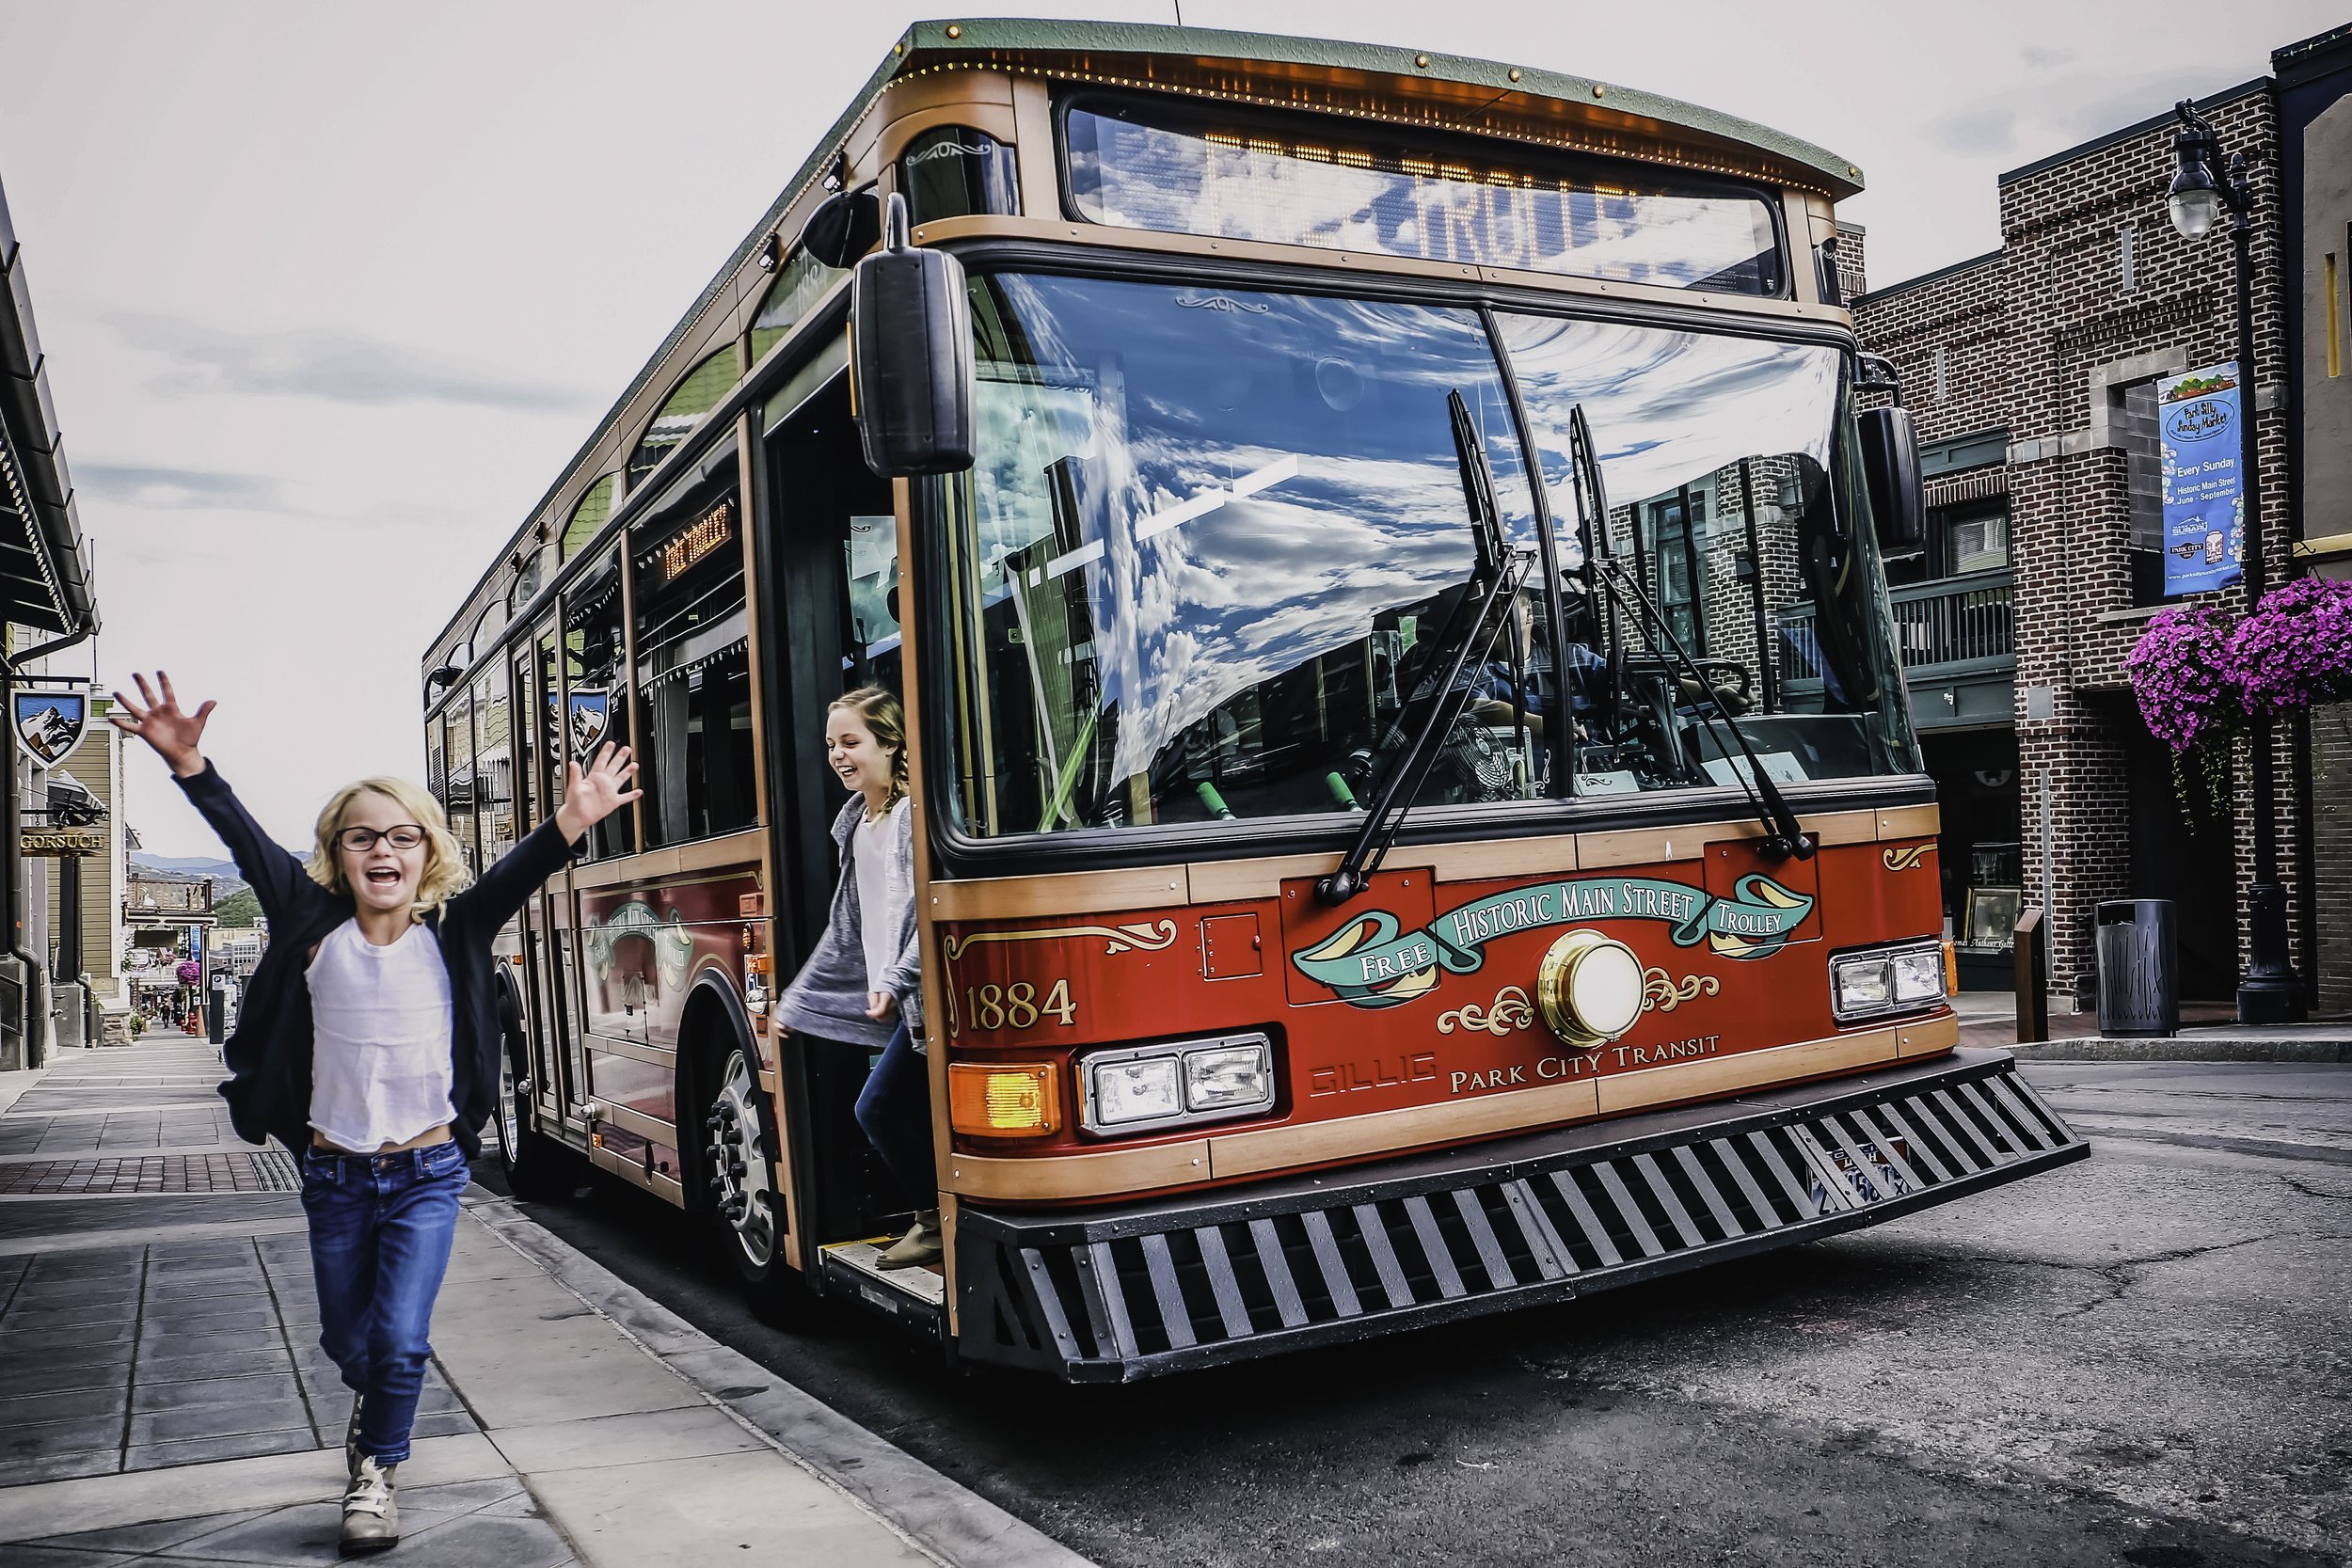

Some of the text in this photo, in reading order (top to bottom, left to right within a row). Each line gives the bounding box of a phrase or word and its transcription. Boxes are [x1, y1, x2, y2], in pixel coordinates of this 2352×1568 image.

[2184, 403, 2217, 420] Park Silly
[2177, 420, 2200, 435] Sunday
[2201, 412, 2227, 430] Market
[2177, 458, 2234, 478] Every Sunday
[2177, 476, 2235, 495] Historic Main Street
[2200, 488, 2235, 500] September
[20, 834, 103, 848] GORSUCH
[1359, 882, 1783, 981] FREE HISTORIC MAIN STREET TROLLEY
[966, 979, 1077, 1030] 1884
[1309, 1052, 1437, 1098] GILLIG
[1450, 1035, 1720, 1094] PARK CITY TRANSIT
